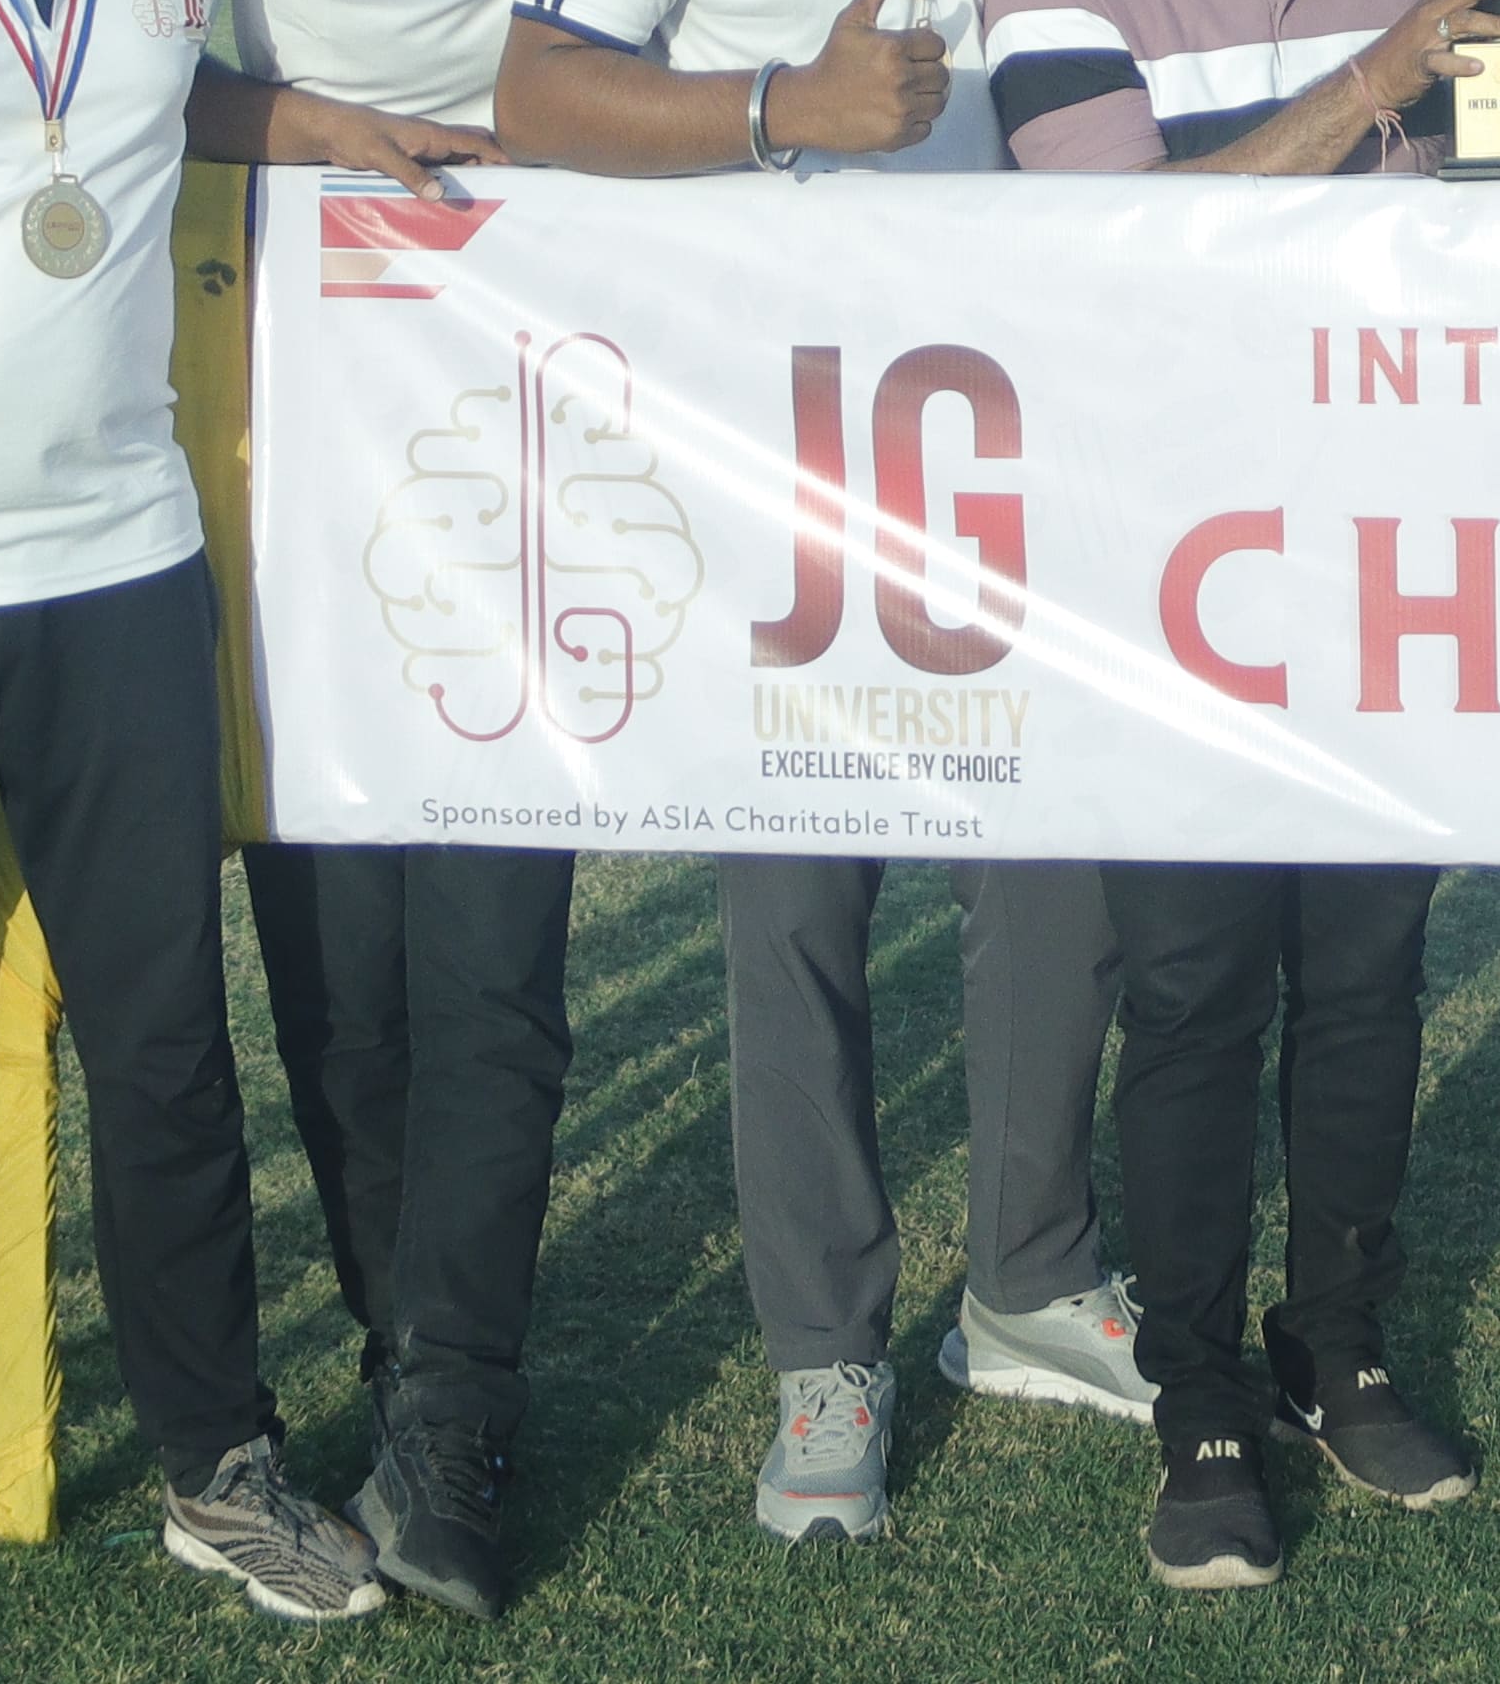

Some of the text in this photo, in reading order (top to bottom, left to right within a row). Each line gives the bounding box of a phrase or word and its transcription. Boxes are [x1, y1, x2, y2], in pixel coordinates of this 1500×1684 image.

[1468, 98, 1497, 110] INTER
[749, 343, 1027, 676] JG
[752, 683, 1031, 749] UNIVERSITY
[760, 749, 1022, 784] EXCELLENCE BY CHOICE
[421, 798, 984, 838] Sponsored by ASIA Charitable Trust
[1196, 1439, 1241, 1461] AIR
